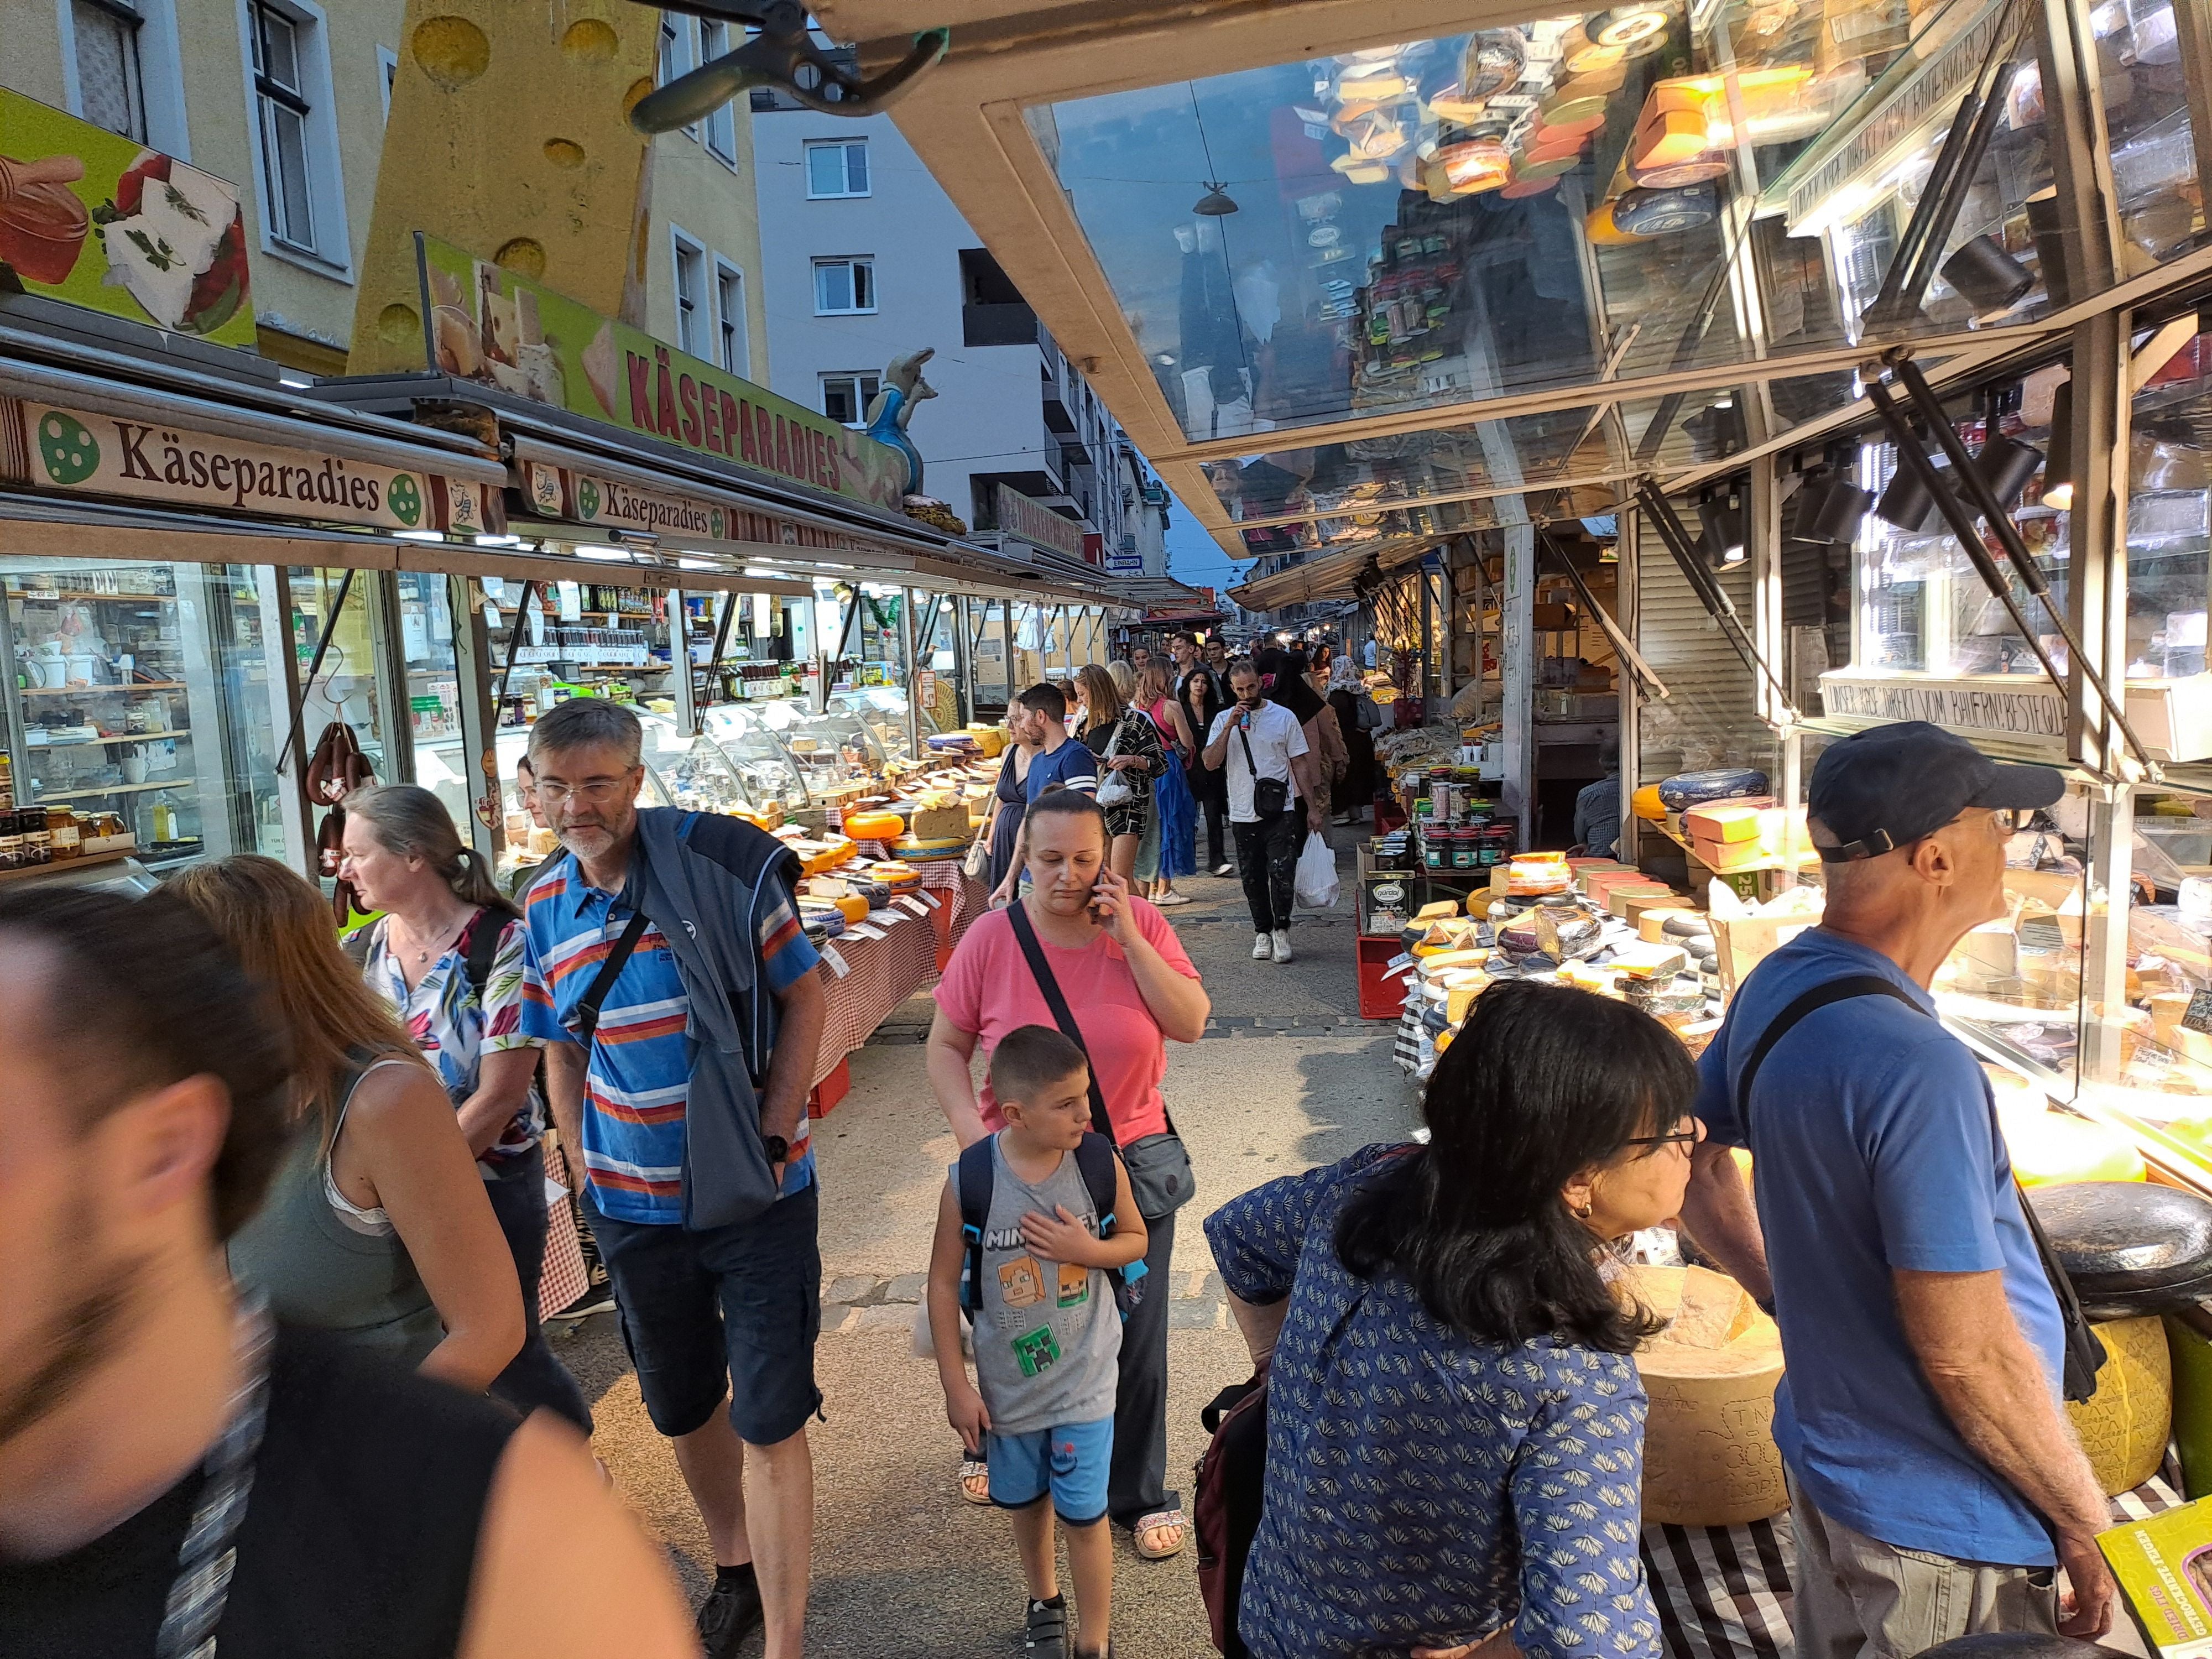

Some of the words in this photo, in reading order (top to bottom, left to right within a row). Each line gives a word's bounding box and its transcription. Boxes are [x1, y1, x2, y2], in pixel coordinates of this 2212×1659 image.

[626, 345, 841, 491] KÄSEPARADIES
[112, 420, 380, 512] Käseparadies
[604, 482, 708, 533] Käseparadies
[1829, 685, 1858, 714] UNSER
[1917, 690, 1947, 724] VOM
[986, 1212, 1098, 1251] MINFT
[1726, 1439, 1778, 1469] 300
[2134, 1529, 2166, 1572] FEIGEN
[2150, 1585, 2169, 1608] FIGS
[2157, 1564, 2208, 1637] GETROCKNETE
[2164, 1608, 2190, 1641] DRIED
